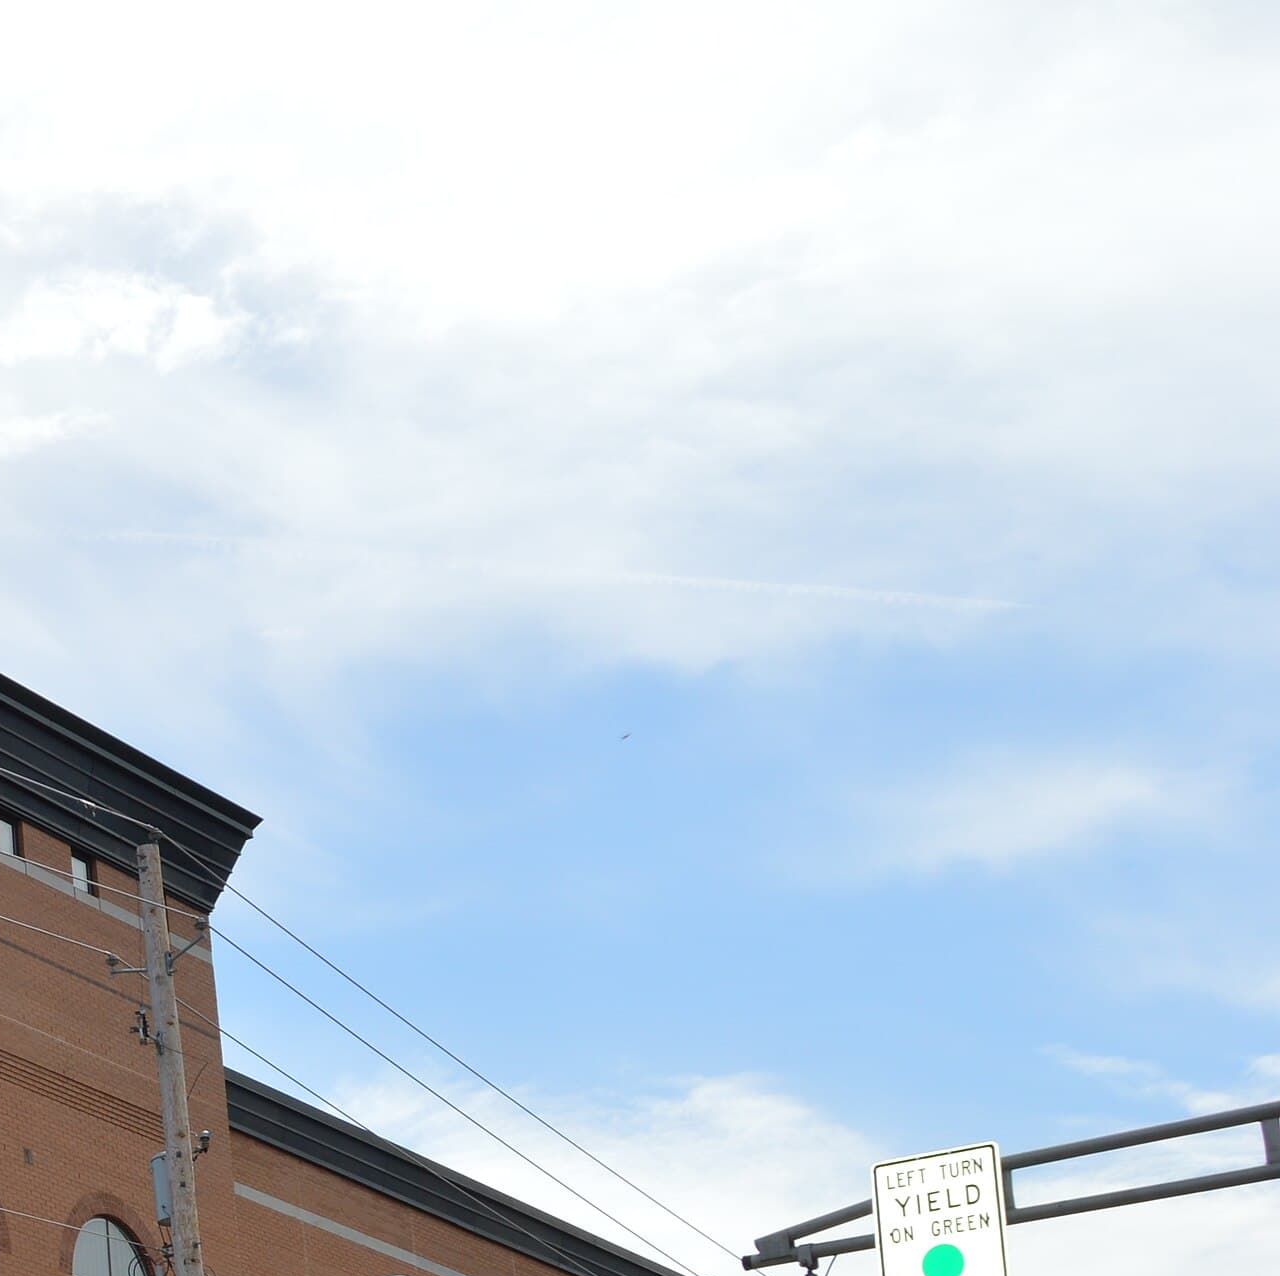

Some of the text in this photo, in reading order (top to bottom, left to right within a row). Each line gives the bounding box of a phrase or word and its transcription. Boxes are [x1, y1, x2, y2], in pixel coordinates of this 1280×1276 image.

[887, 1158, 983, 1190] LEFT TURN
[895, 1184, 981, 1217] YIELD
[890, 1212, 990, 1244] ON GREEN
